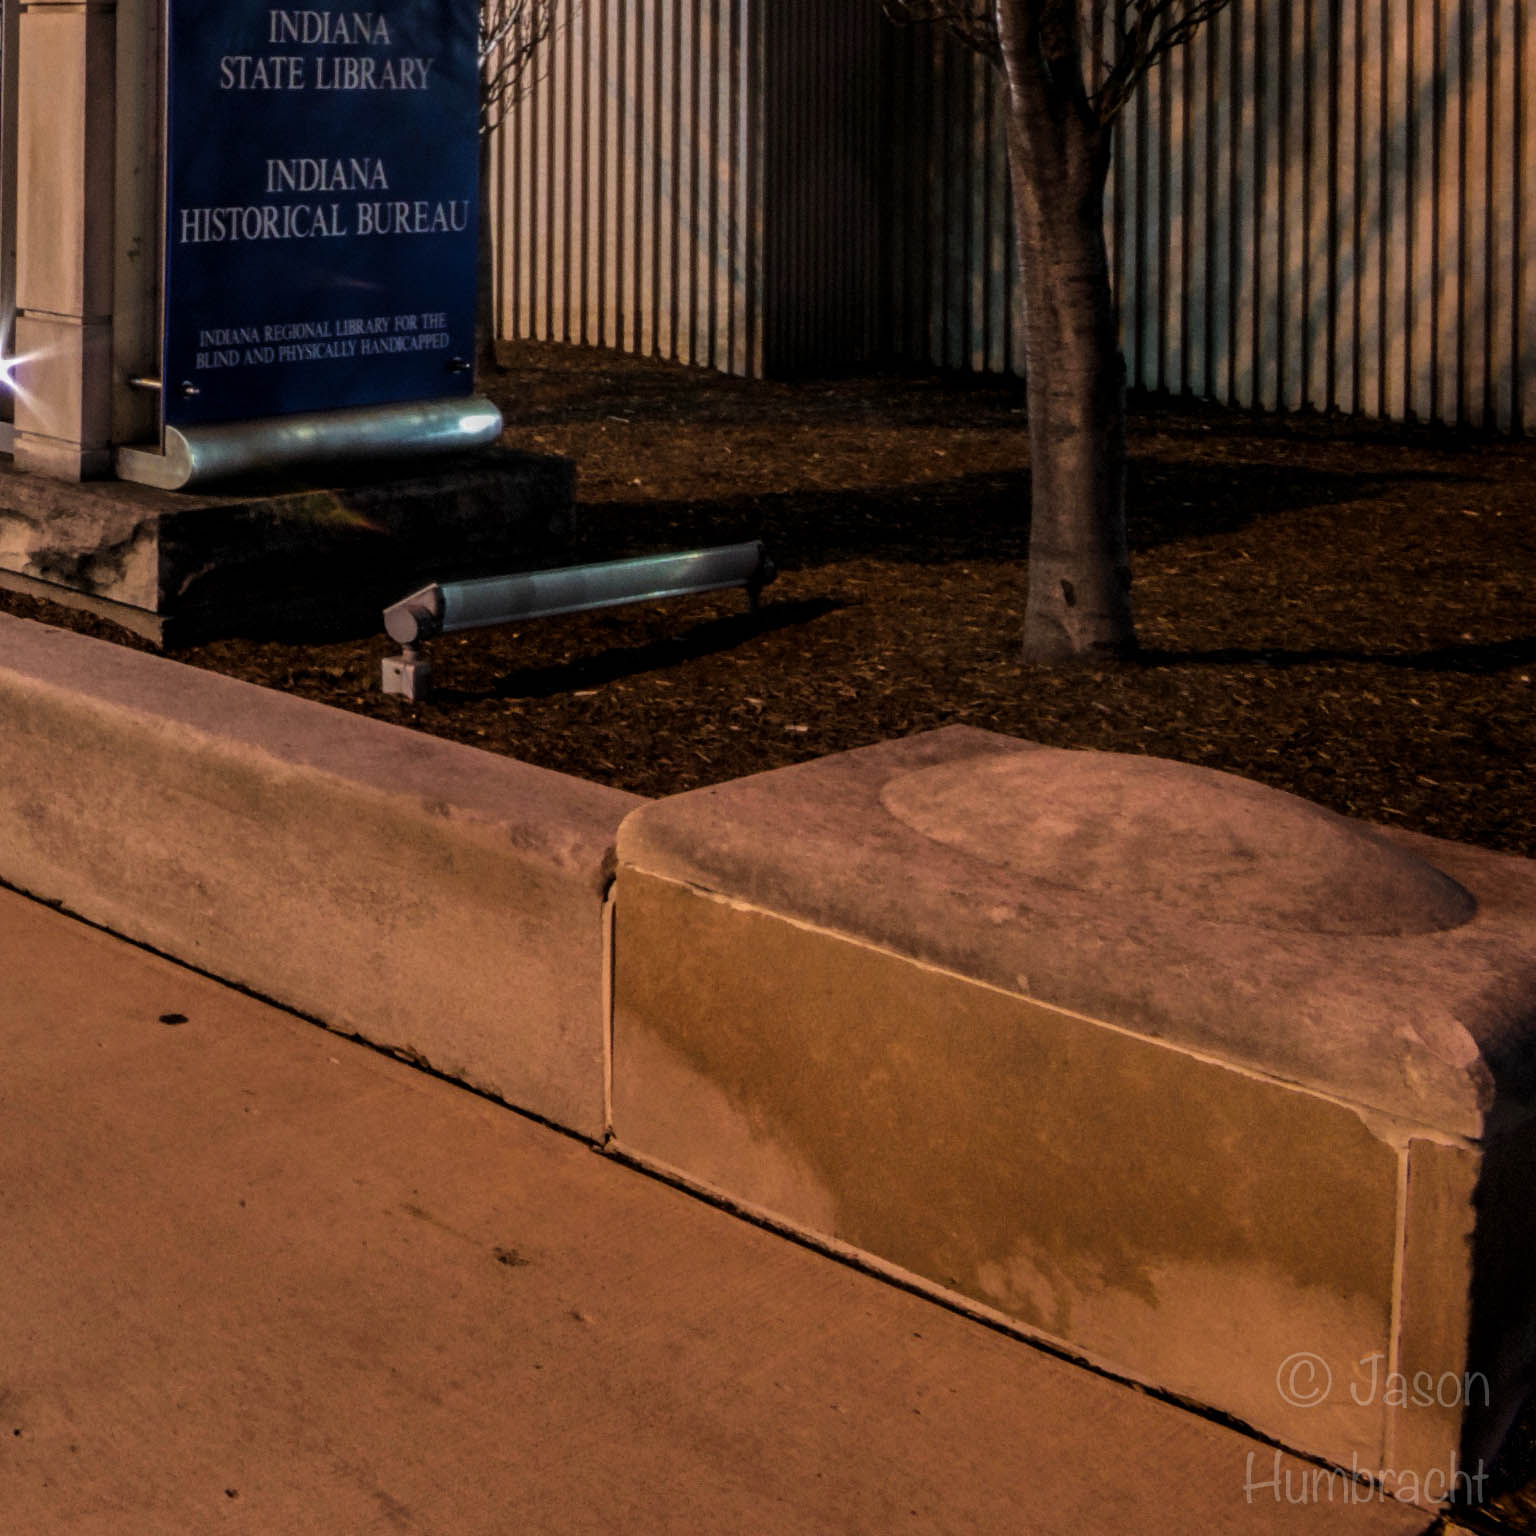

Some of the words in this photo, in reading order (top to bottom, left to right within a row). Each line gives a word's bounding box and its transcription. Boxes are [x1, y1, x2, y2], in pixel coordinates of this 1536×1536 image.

[268, 10, 392, 45] INDIANA
[220, 55, 305, 90] STATE
[315, 56, 434, 91] LIBRARY
[265, 157, 389, 193] INDIANA
[179, 203, 347, 244] HISTORICAL
[356, 200, 472, 236] BUREAU
[200, 328, 261, 348] INDIANA
[263, 321, 332, 342] REGIONAL
[335, 316, 391, 336] LIBRARY
[394, 314, 418, 333] FOR
[421, 312, 448, 329] THE
[196, 349, 240, 369] BLIND
[244, 346, 274, 365] AND
[278, 339, 357, 362] PHYSICALLY
[360, 332, 450, 355] HANDICAPPED
